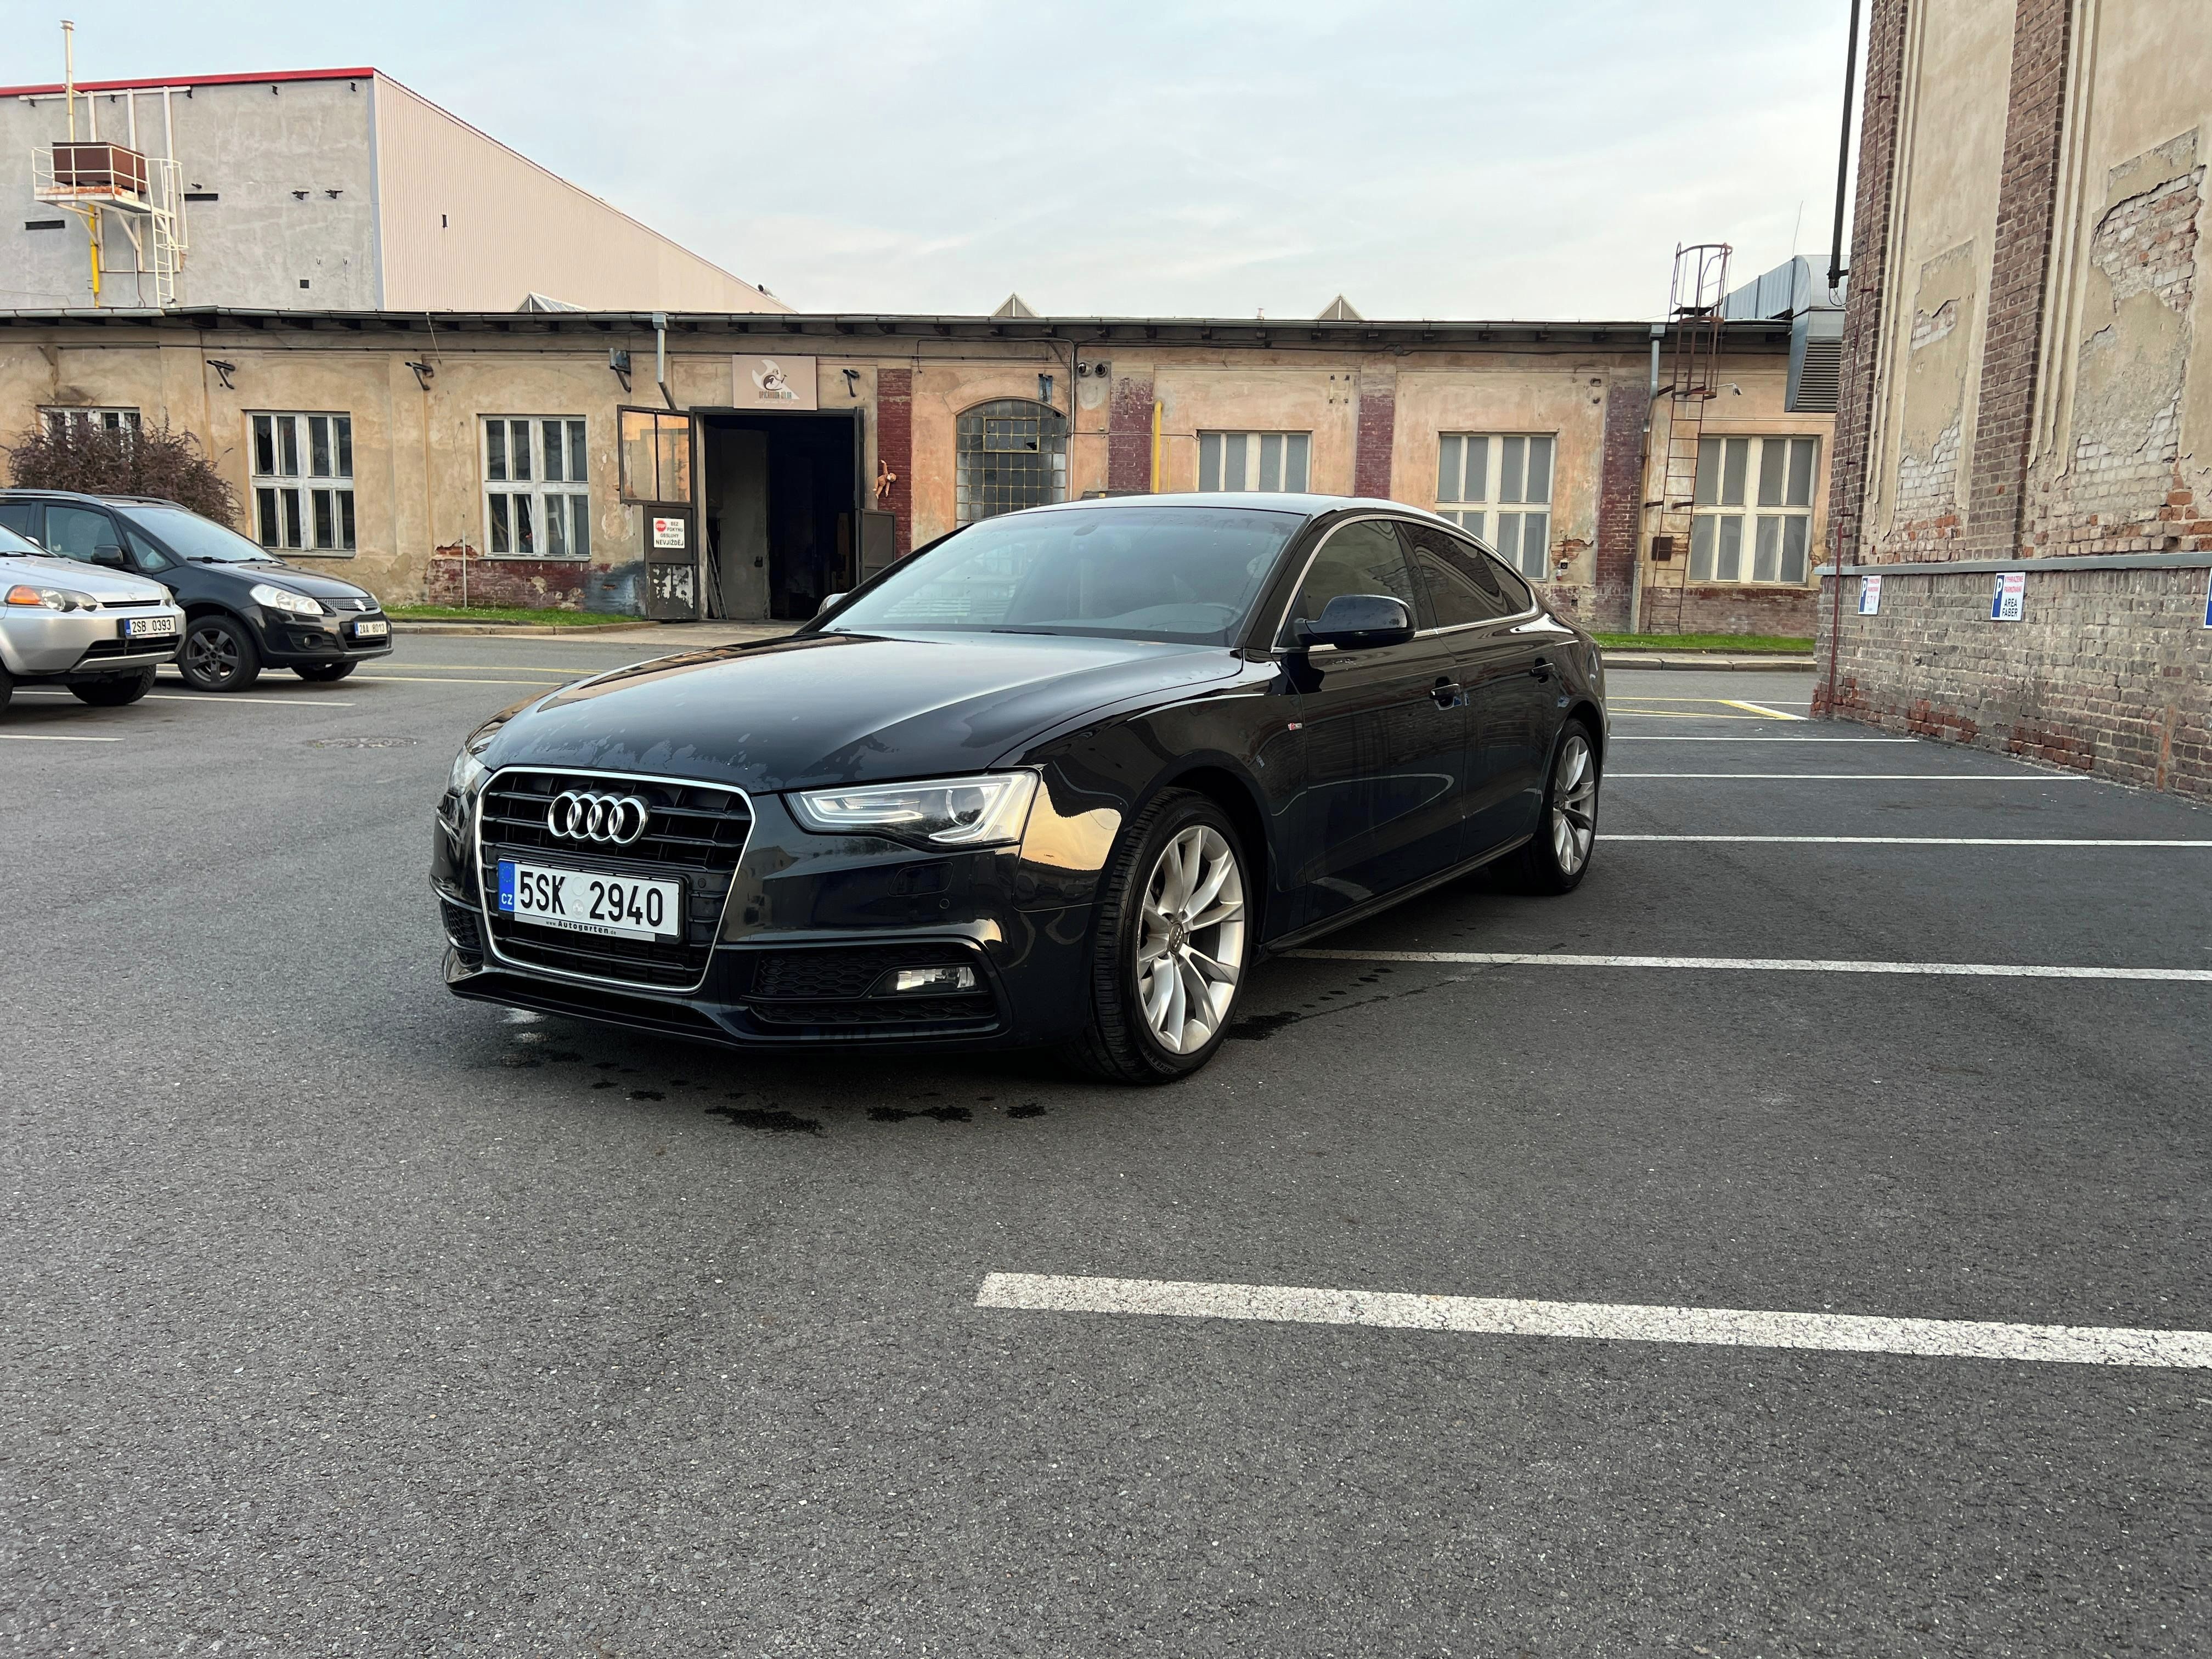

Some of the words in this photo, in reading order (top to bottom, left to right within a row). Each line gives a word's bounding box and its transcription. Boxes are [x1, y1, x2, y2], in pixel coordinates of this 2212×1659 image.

[1995, 578, 2003, 599] P
[2004, 598, 2017, 607] AREA
[2002, 608, 2018, 617] FABER
[132, 620, 146, 633] 2SB
[152, 619, 171, 631] 0393
[501, 893, 513, 905] CZ
[520, 871, 566, 915] 5SK
[589, 881, 663, 927] 2940
